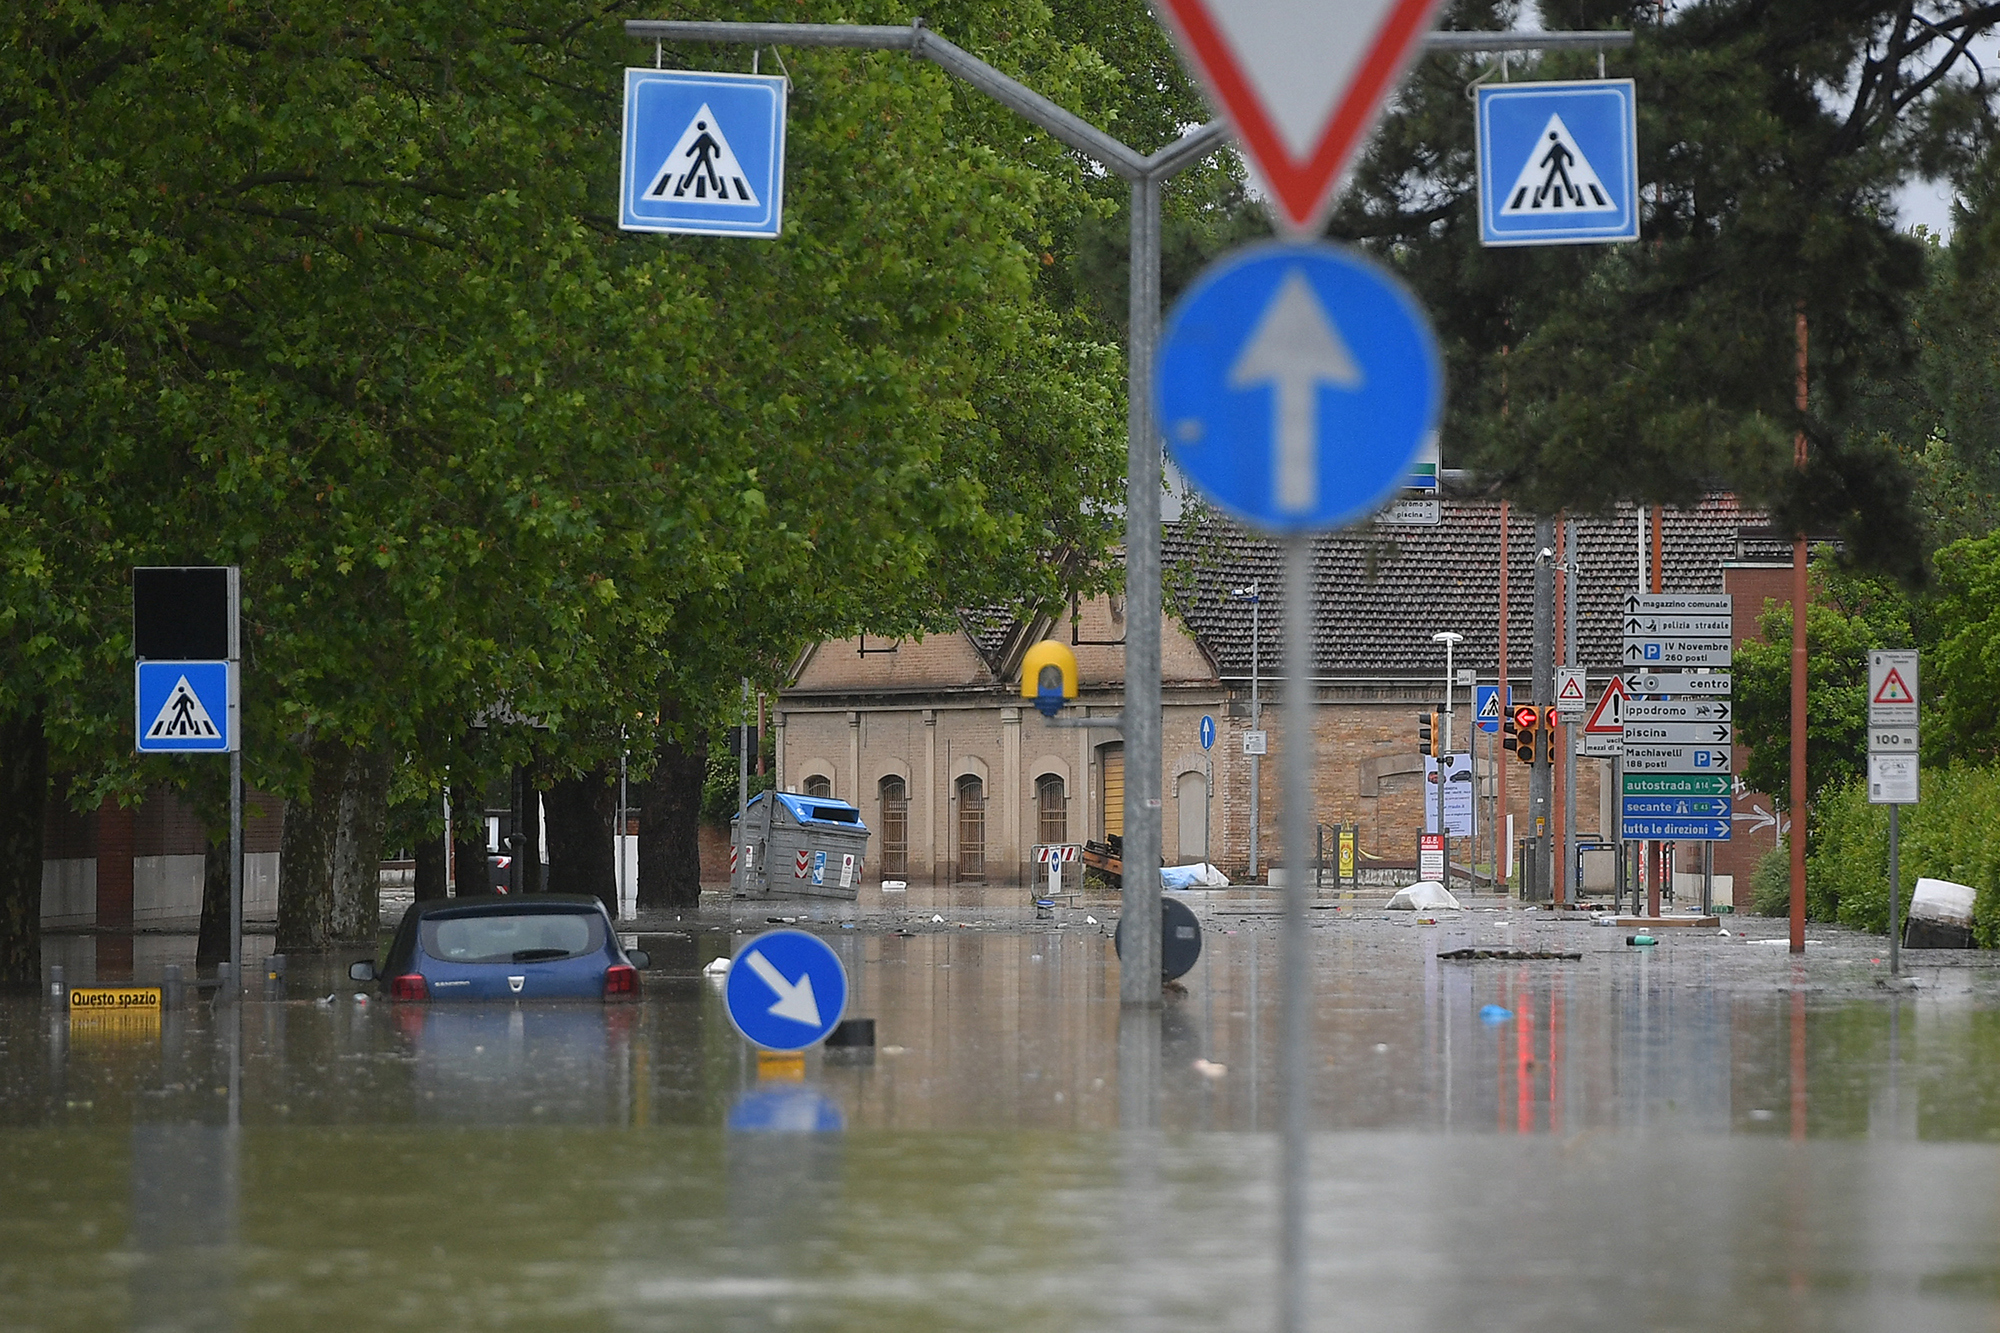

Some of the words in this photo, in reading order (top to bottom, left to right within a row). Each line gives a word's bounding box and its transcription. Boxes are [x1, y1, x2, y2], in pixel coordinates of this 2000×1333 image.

[1643, 600, 1685, 609] magazzino
[1687, 600, 1728, 608] comunale
[1662, 622, 1690, 630] polizia
[1695, 621, 1729, 629] stradale
[1664, 643, 1675, 651] IV
[1678, 642, 1728, 651] Novembre
[1664, 654, 1682, 662] 260
[1685, 654, 1708, 663] posti
[1689, 679, 1729, 688] centro
[1625, 706, 1687, 716] ippodromo
[1625, 728, 1667, 738] piscina
[1875, 734, 1900, 745] 100
[1626, 749, 1682, 757] Machiavelli
[1626, 760, 1643, 768] 188
[1645, 760, 1668, 769] posti
[1626, 780, 1691, 790] autostrada
[1626, 803, 1672, 812] secante
[1623, 824, 1649, 834] tutte
[1652, 823, 1662, 834] le
[1664, 823, 1708, 835] direzioni
[72, 991, 115, 1006] Questo
[118, 991, 156, 1008] spazio
